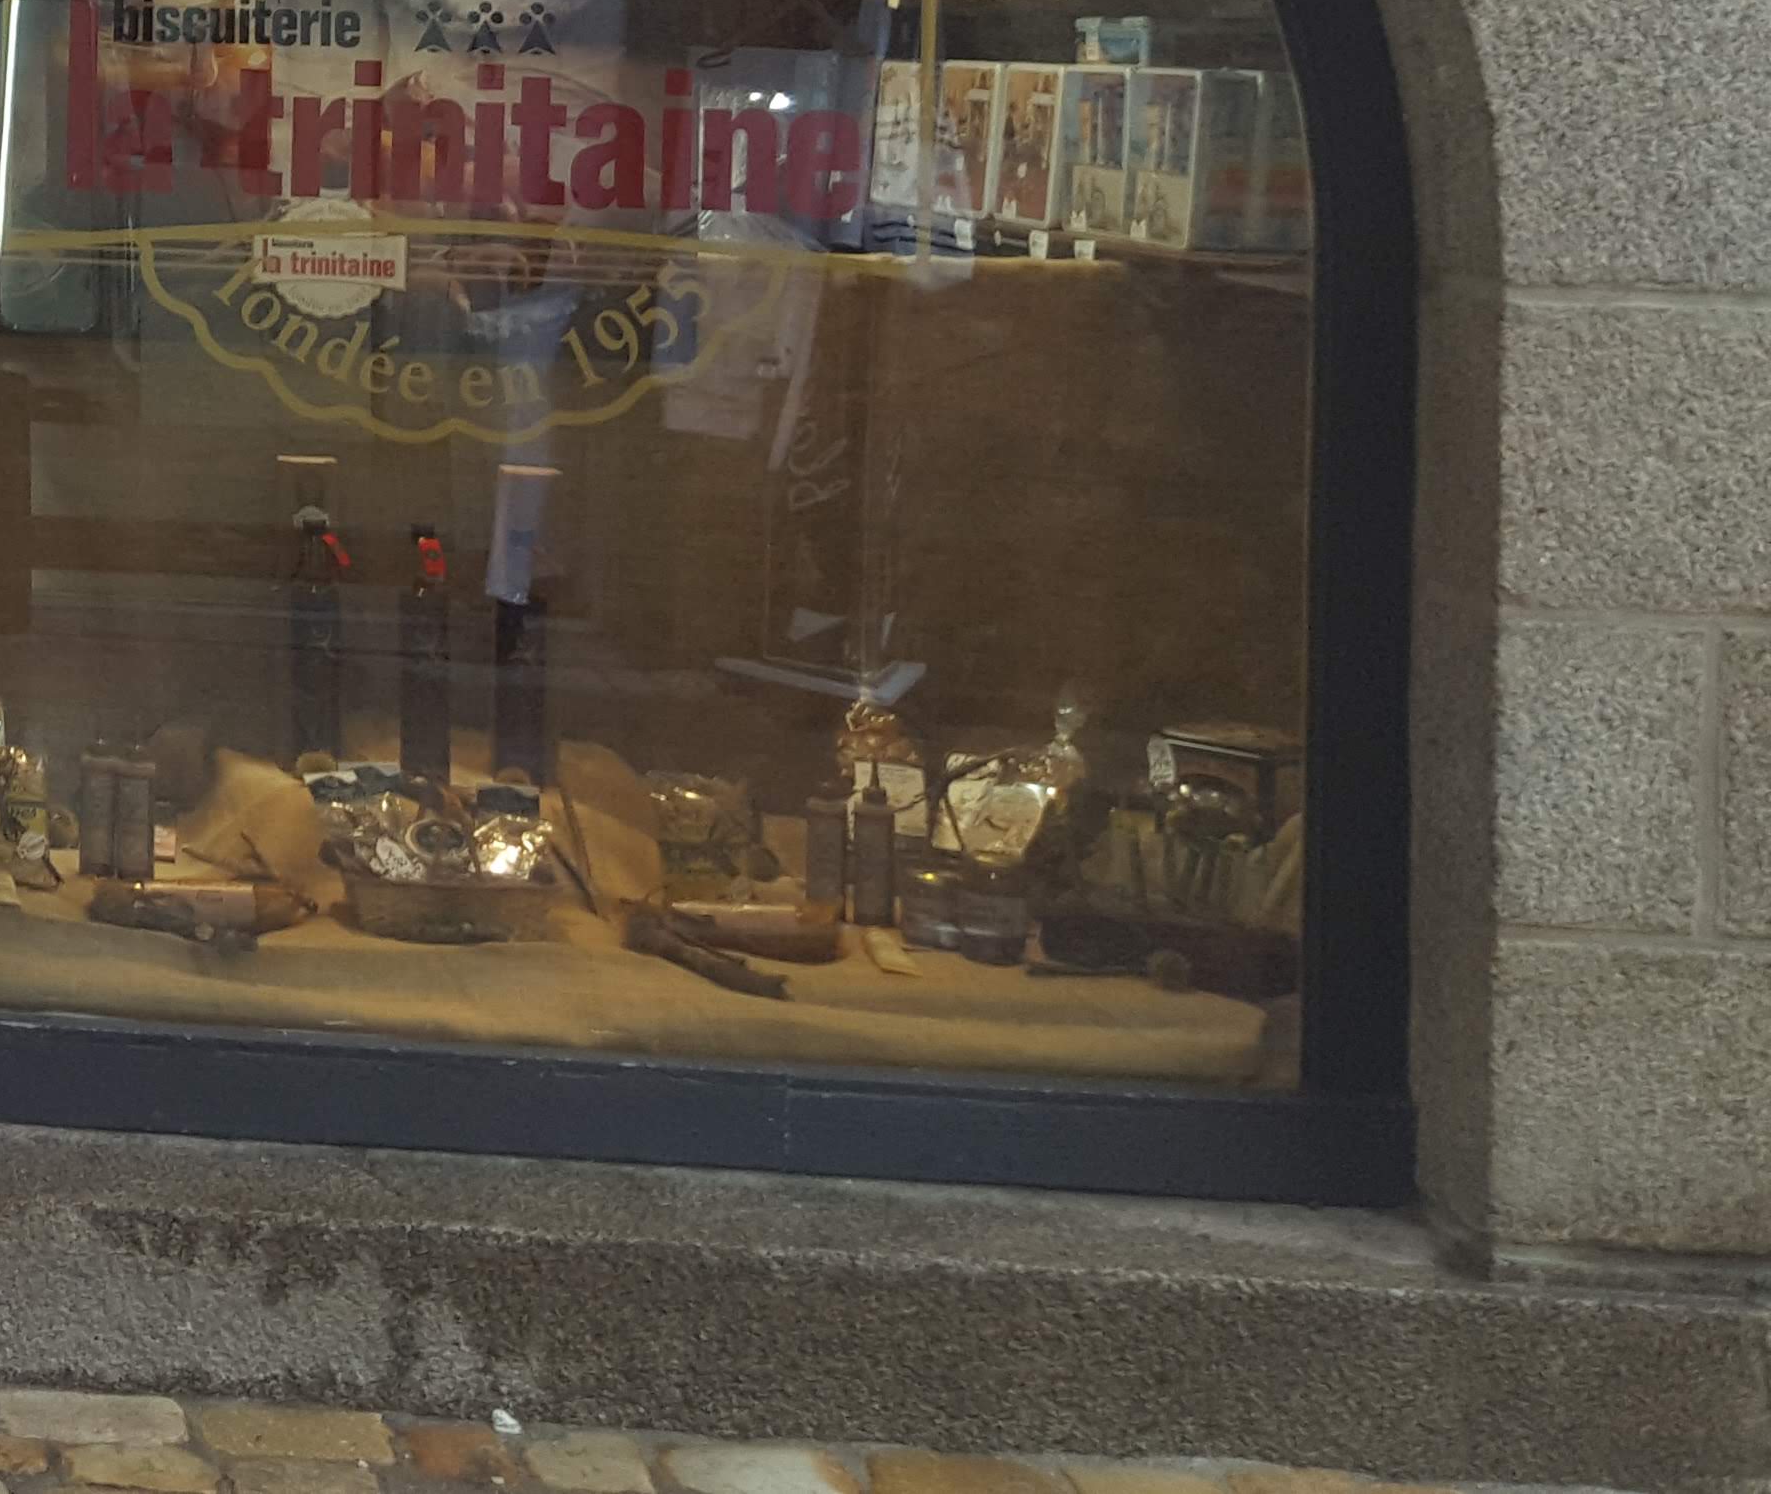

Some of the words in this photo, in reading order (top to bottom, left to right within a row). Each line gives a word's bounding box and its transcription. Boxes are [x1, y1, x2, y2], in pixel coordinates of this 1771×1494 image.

[227, 61, 861, 220] trinitaine
[213, 254, 434, 404] fondée
[461, 359, 547, 406] en
[562, 263, 712, 388] 1955
[262, 238, 281, 273] la
[291, 251, 396, 278] trinitaine
